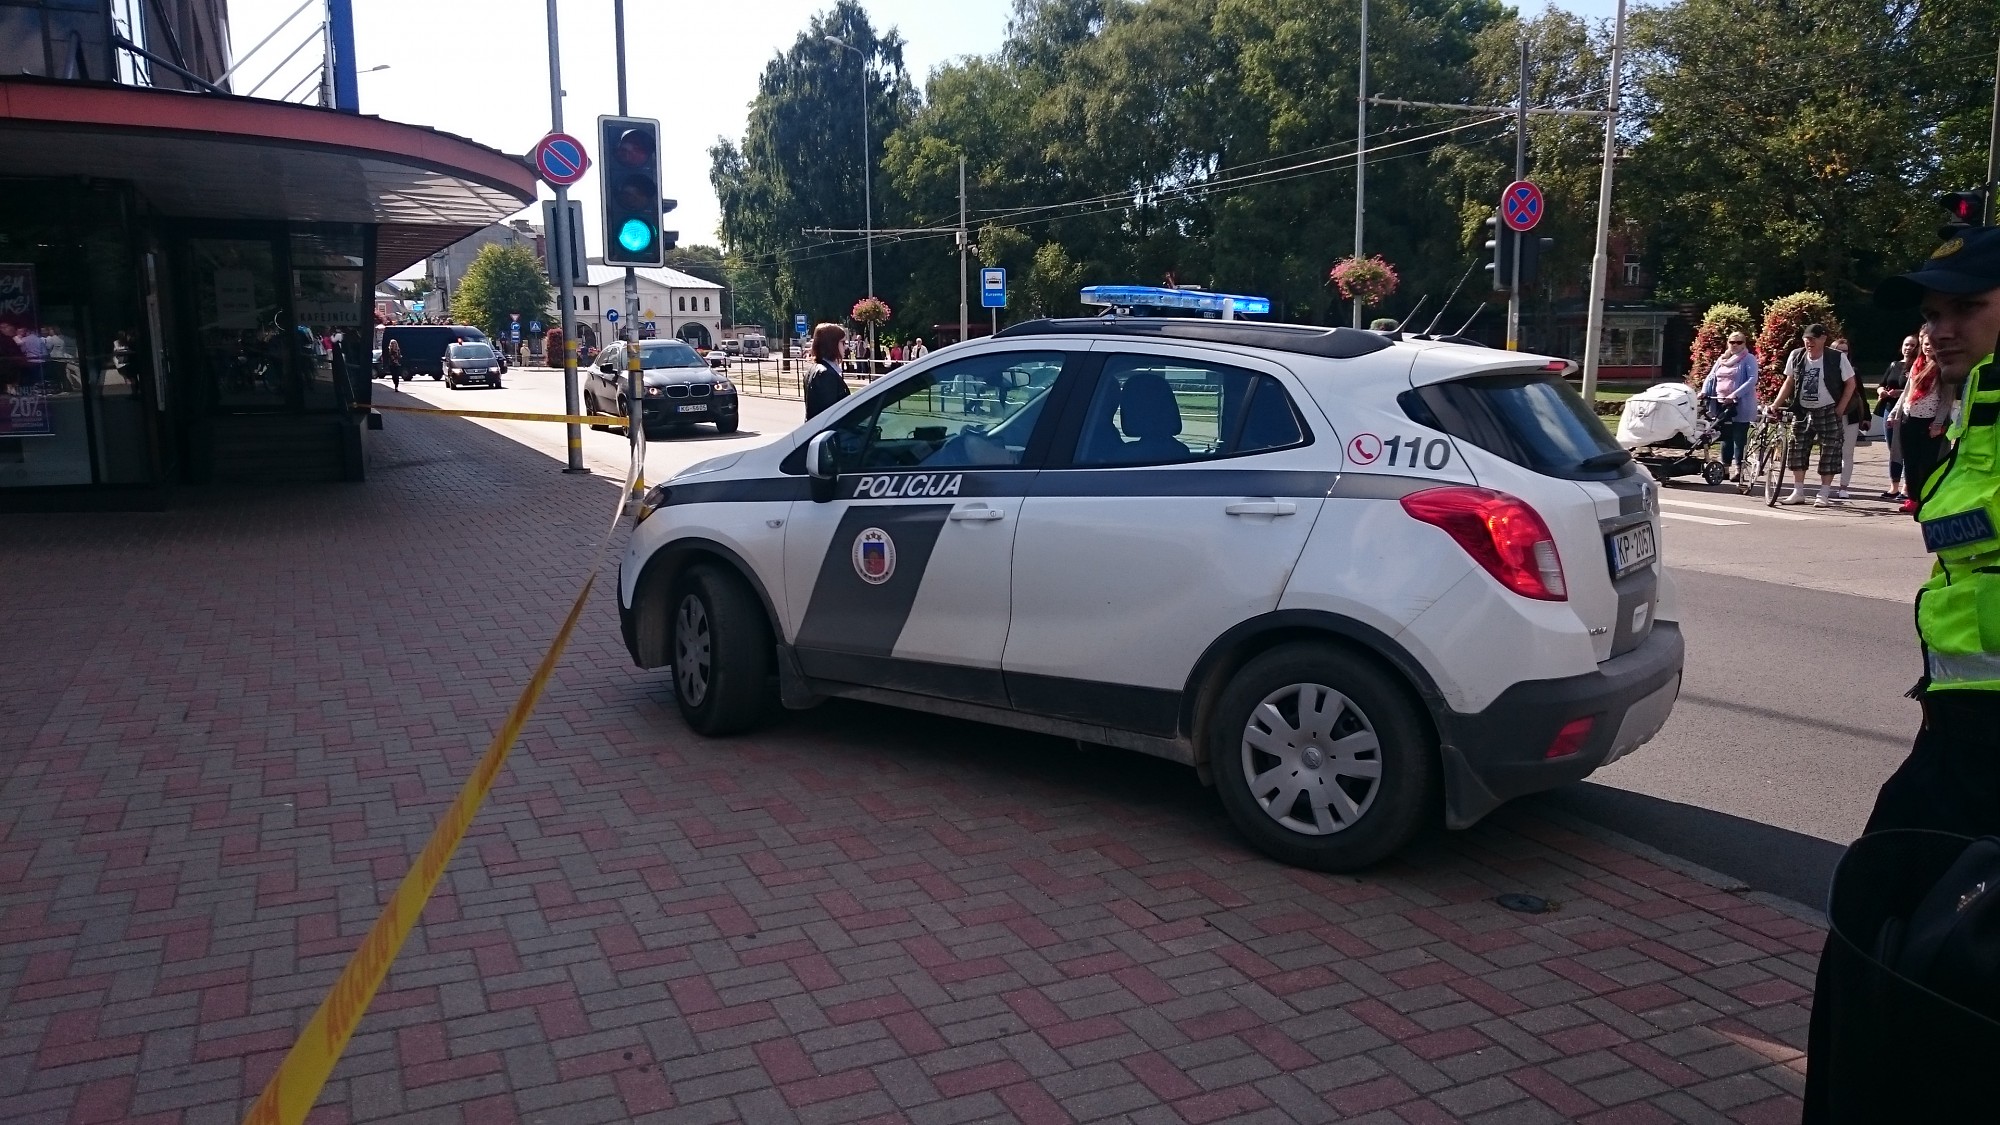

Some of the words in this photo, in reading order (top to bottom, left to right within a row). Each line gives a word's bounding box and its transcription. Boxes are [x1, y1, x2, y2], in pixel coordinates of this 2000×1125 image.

[300, 311, 358, 321] KAFEJNĪCA
[10, 397, 42, 417] 20%
[1384, 435, 1451, 470] 110
[853, 475, 963, 497] POLICIJA
[1926, 514, 1989, 545] POLICIJA
[1617, 526, 1652, 565] KP-2057
